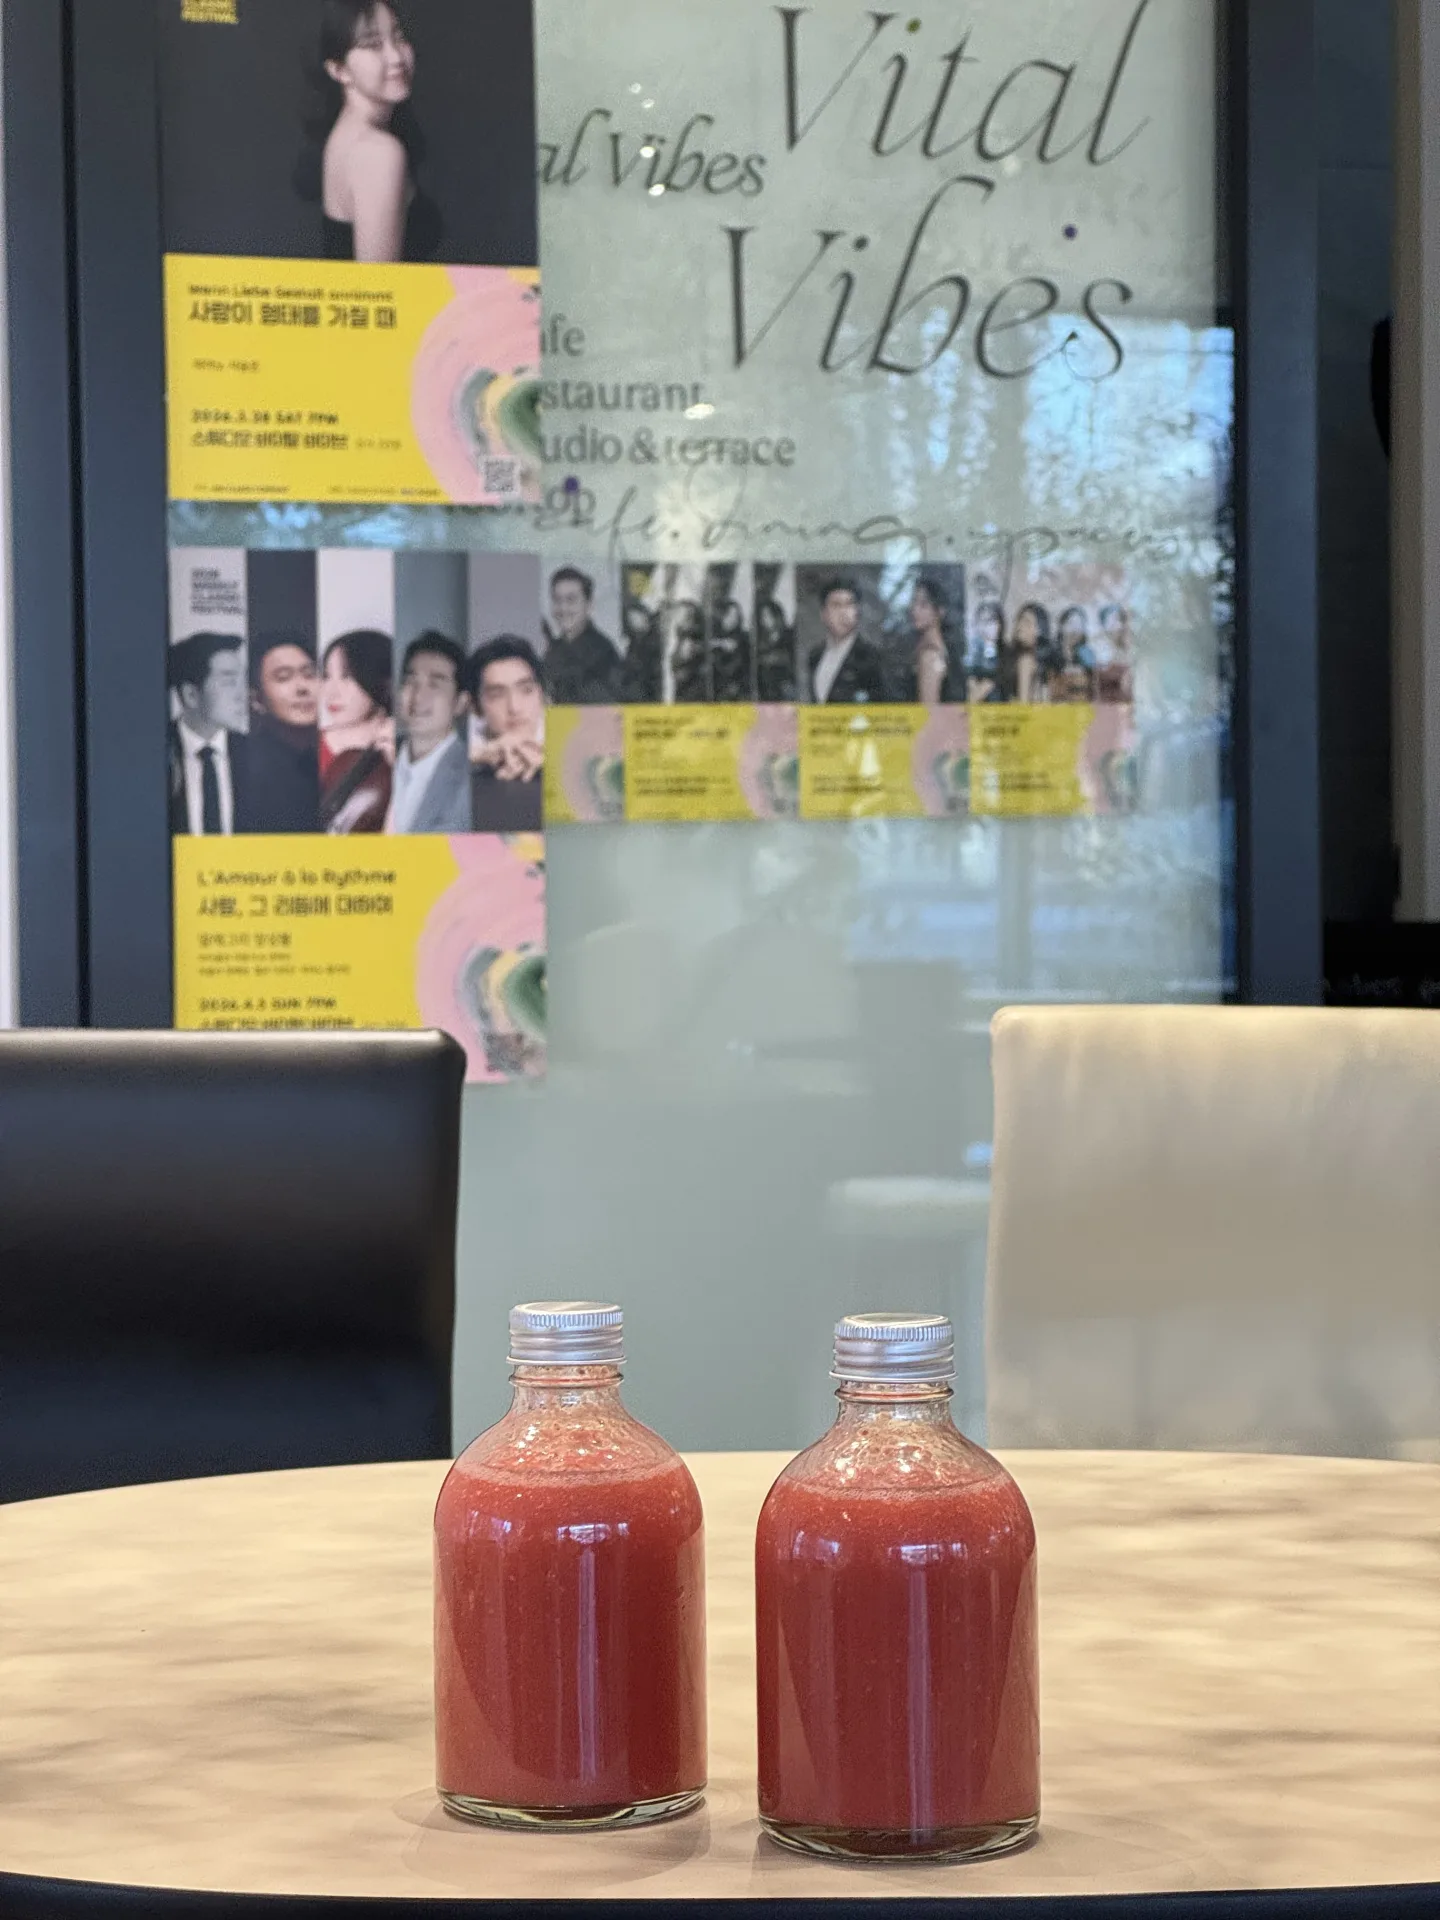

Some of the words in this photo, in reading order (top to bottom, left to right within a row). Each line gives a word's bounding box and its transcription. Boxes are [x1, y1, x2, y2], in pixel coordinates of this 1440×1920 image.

[774, 0, 1150, 166] Vital
[610, 113, 767, 197] Vibes
[719, 175, 1133, 383] Vibes
[628, 426, 660, 465] &
